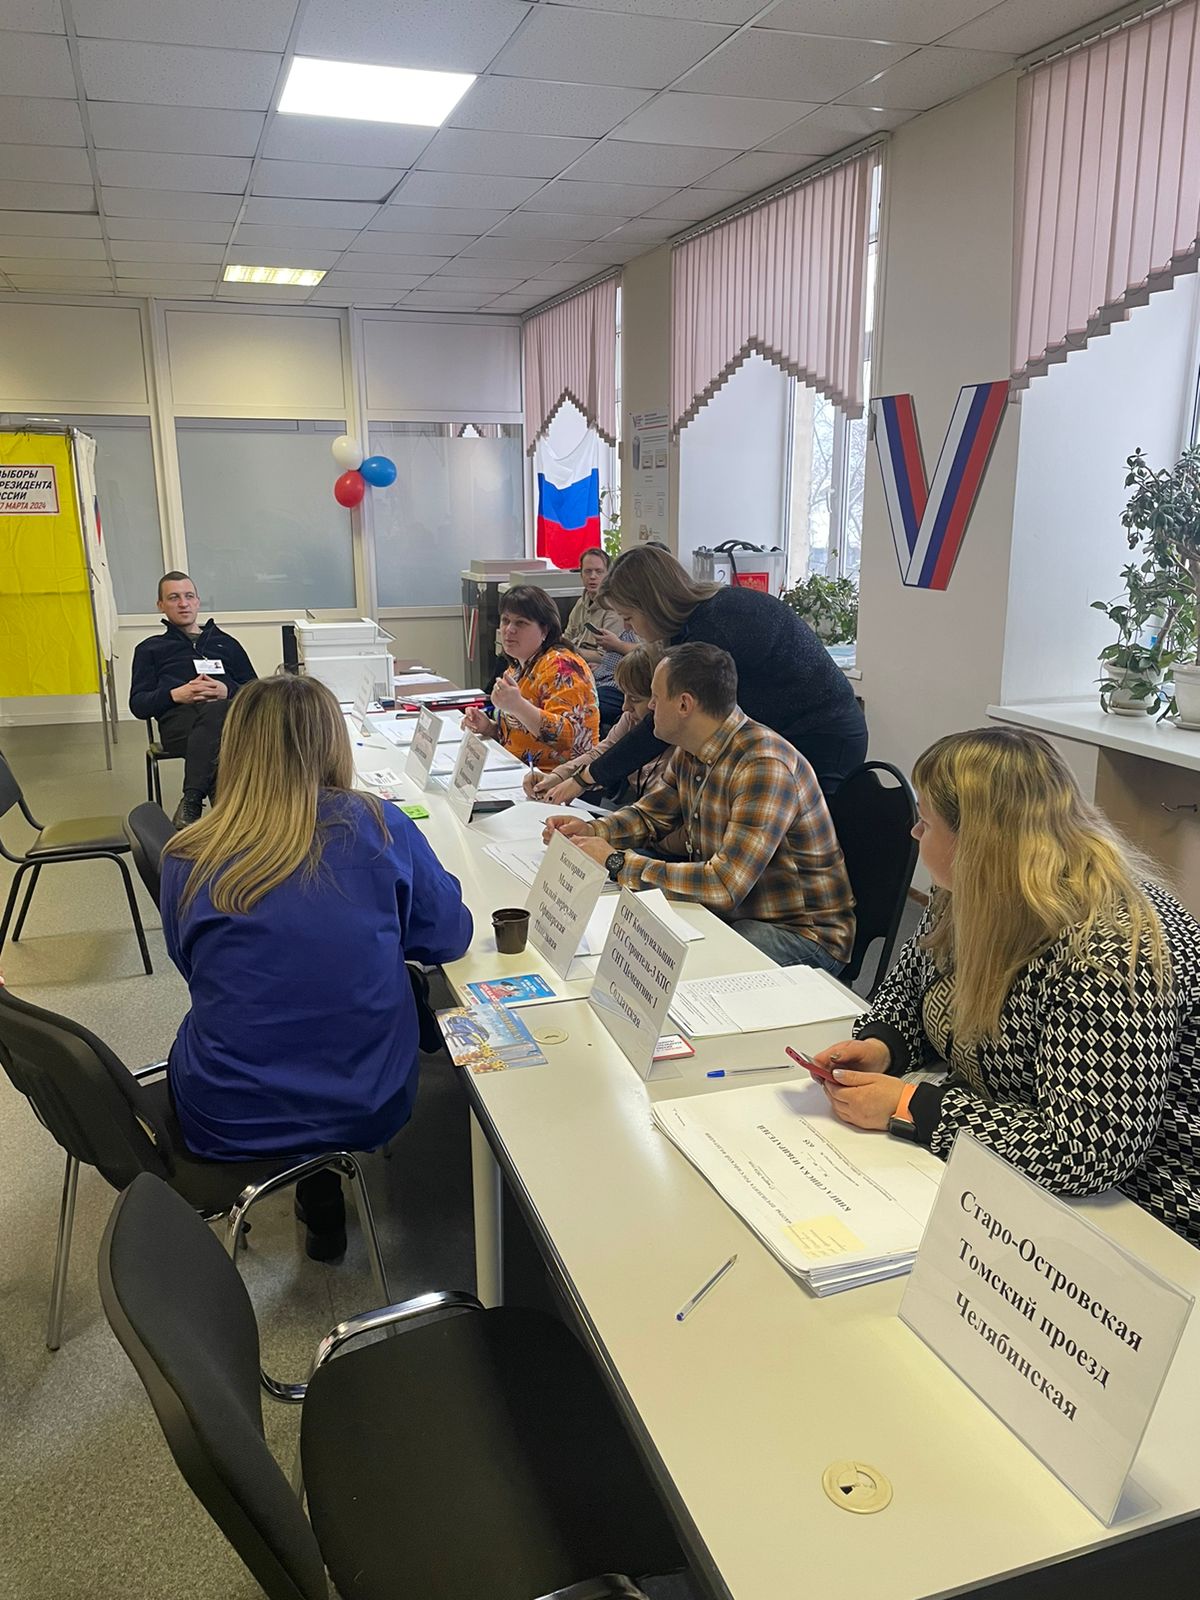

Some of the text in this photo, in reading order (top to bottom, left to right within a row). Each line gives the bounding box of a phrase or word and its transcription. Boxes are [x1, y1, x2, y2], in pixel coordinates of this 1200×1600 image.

[0, 470, 38, 479] ЫБОРЫ
[0, 481, 52, 490] РЕЗИДЕНТА
[0, 492, 27, 500] ССИИ
[5, 502, 28, 510] МАРТА
[29, 502, 46, 510] 2024
[542, 881, 578, 922] Малый переулок
[559, 873, 574, 894] Малая
[538, 901, 566, 935] Офицерская
[620, 904, 676, 970] СНТ Коммунальник
[611, 947, 658, 1009] СНТ Цементник 1
[612, 922, 672, 994] СНТ Строитель-3 КПС
[609, 981, 641, 1029] Солдатская
[757, 1124, 801, 1166] ИЗБИРАТЕЛЕЙ
[799, 1165, 828, 1192] СПИСКА
[826, 1190, 851, 1212] КНИГА
[960, 1190, 1143, 1352] Старо-Островская
[958, 1237, 1111, 1391] Томский проезд
[955, 1290, 1078, 1422] Челябинская
